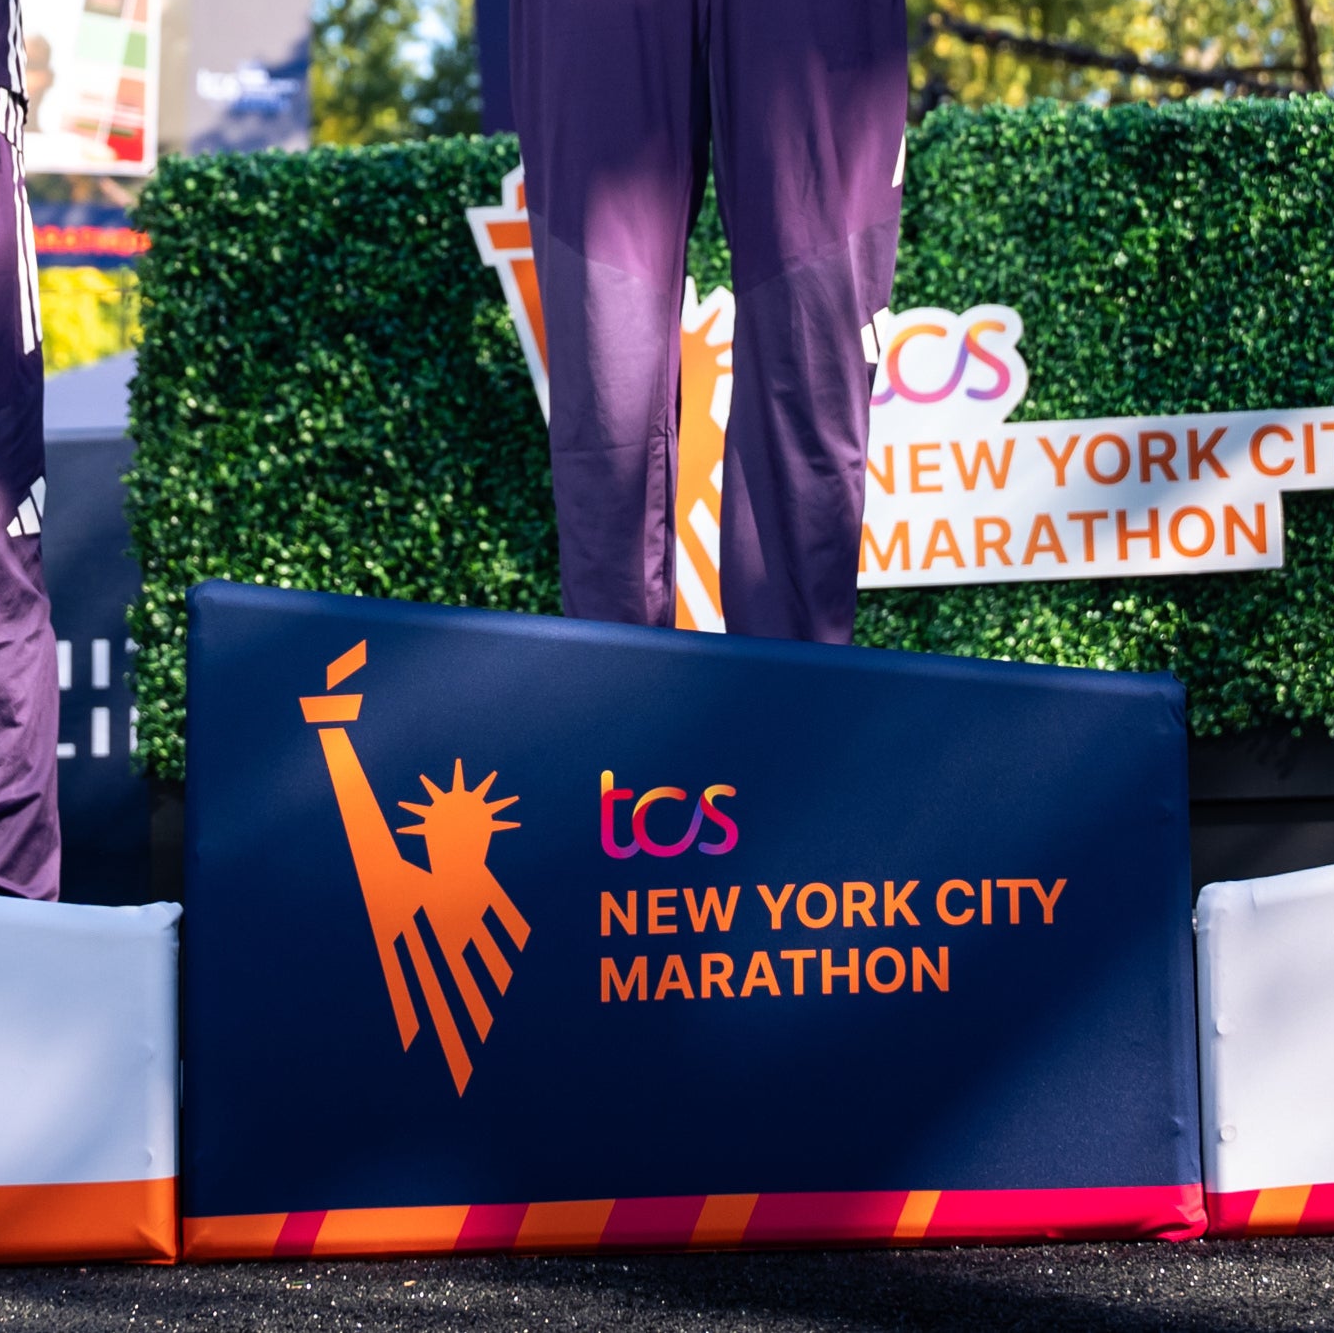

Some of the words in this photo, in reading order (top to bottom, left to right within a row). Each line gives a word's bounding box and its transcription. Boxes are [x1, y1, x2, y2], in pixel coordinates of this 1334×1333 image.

[871, 319, 1012, 406] cs
[866, 439, 1017, 495] NEW
[1038, 425, 1230, 488] YORK
[858, 502, 1268, 573] MARATHON
[600, 769, 740, 859] tcs
[600, 885, 741, 937] NEW
[756, 879, 921, 930] YORK
[935, 878, 1068, 926] CITY
[600, 946, 950, 1003] MARATHON
